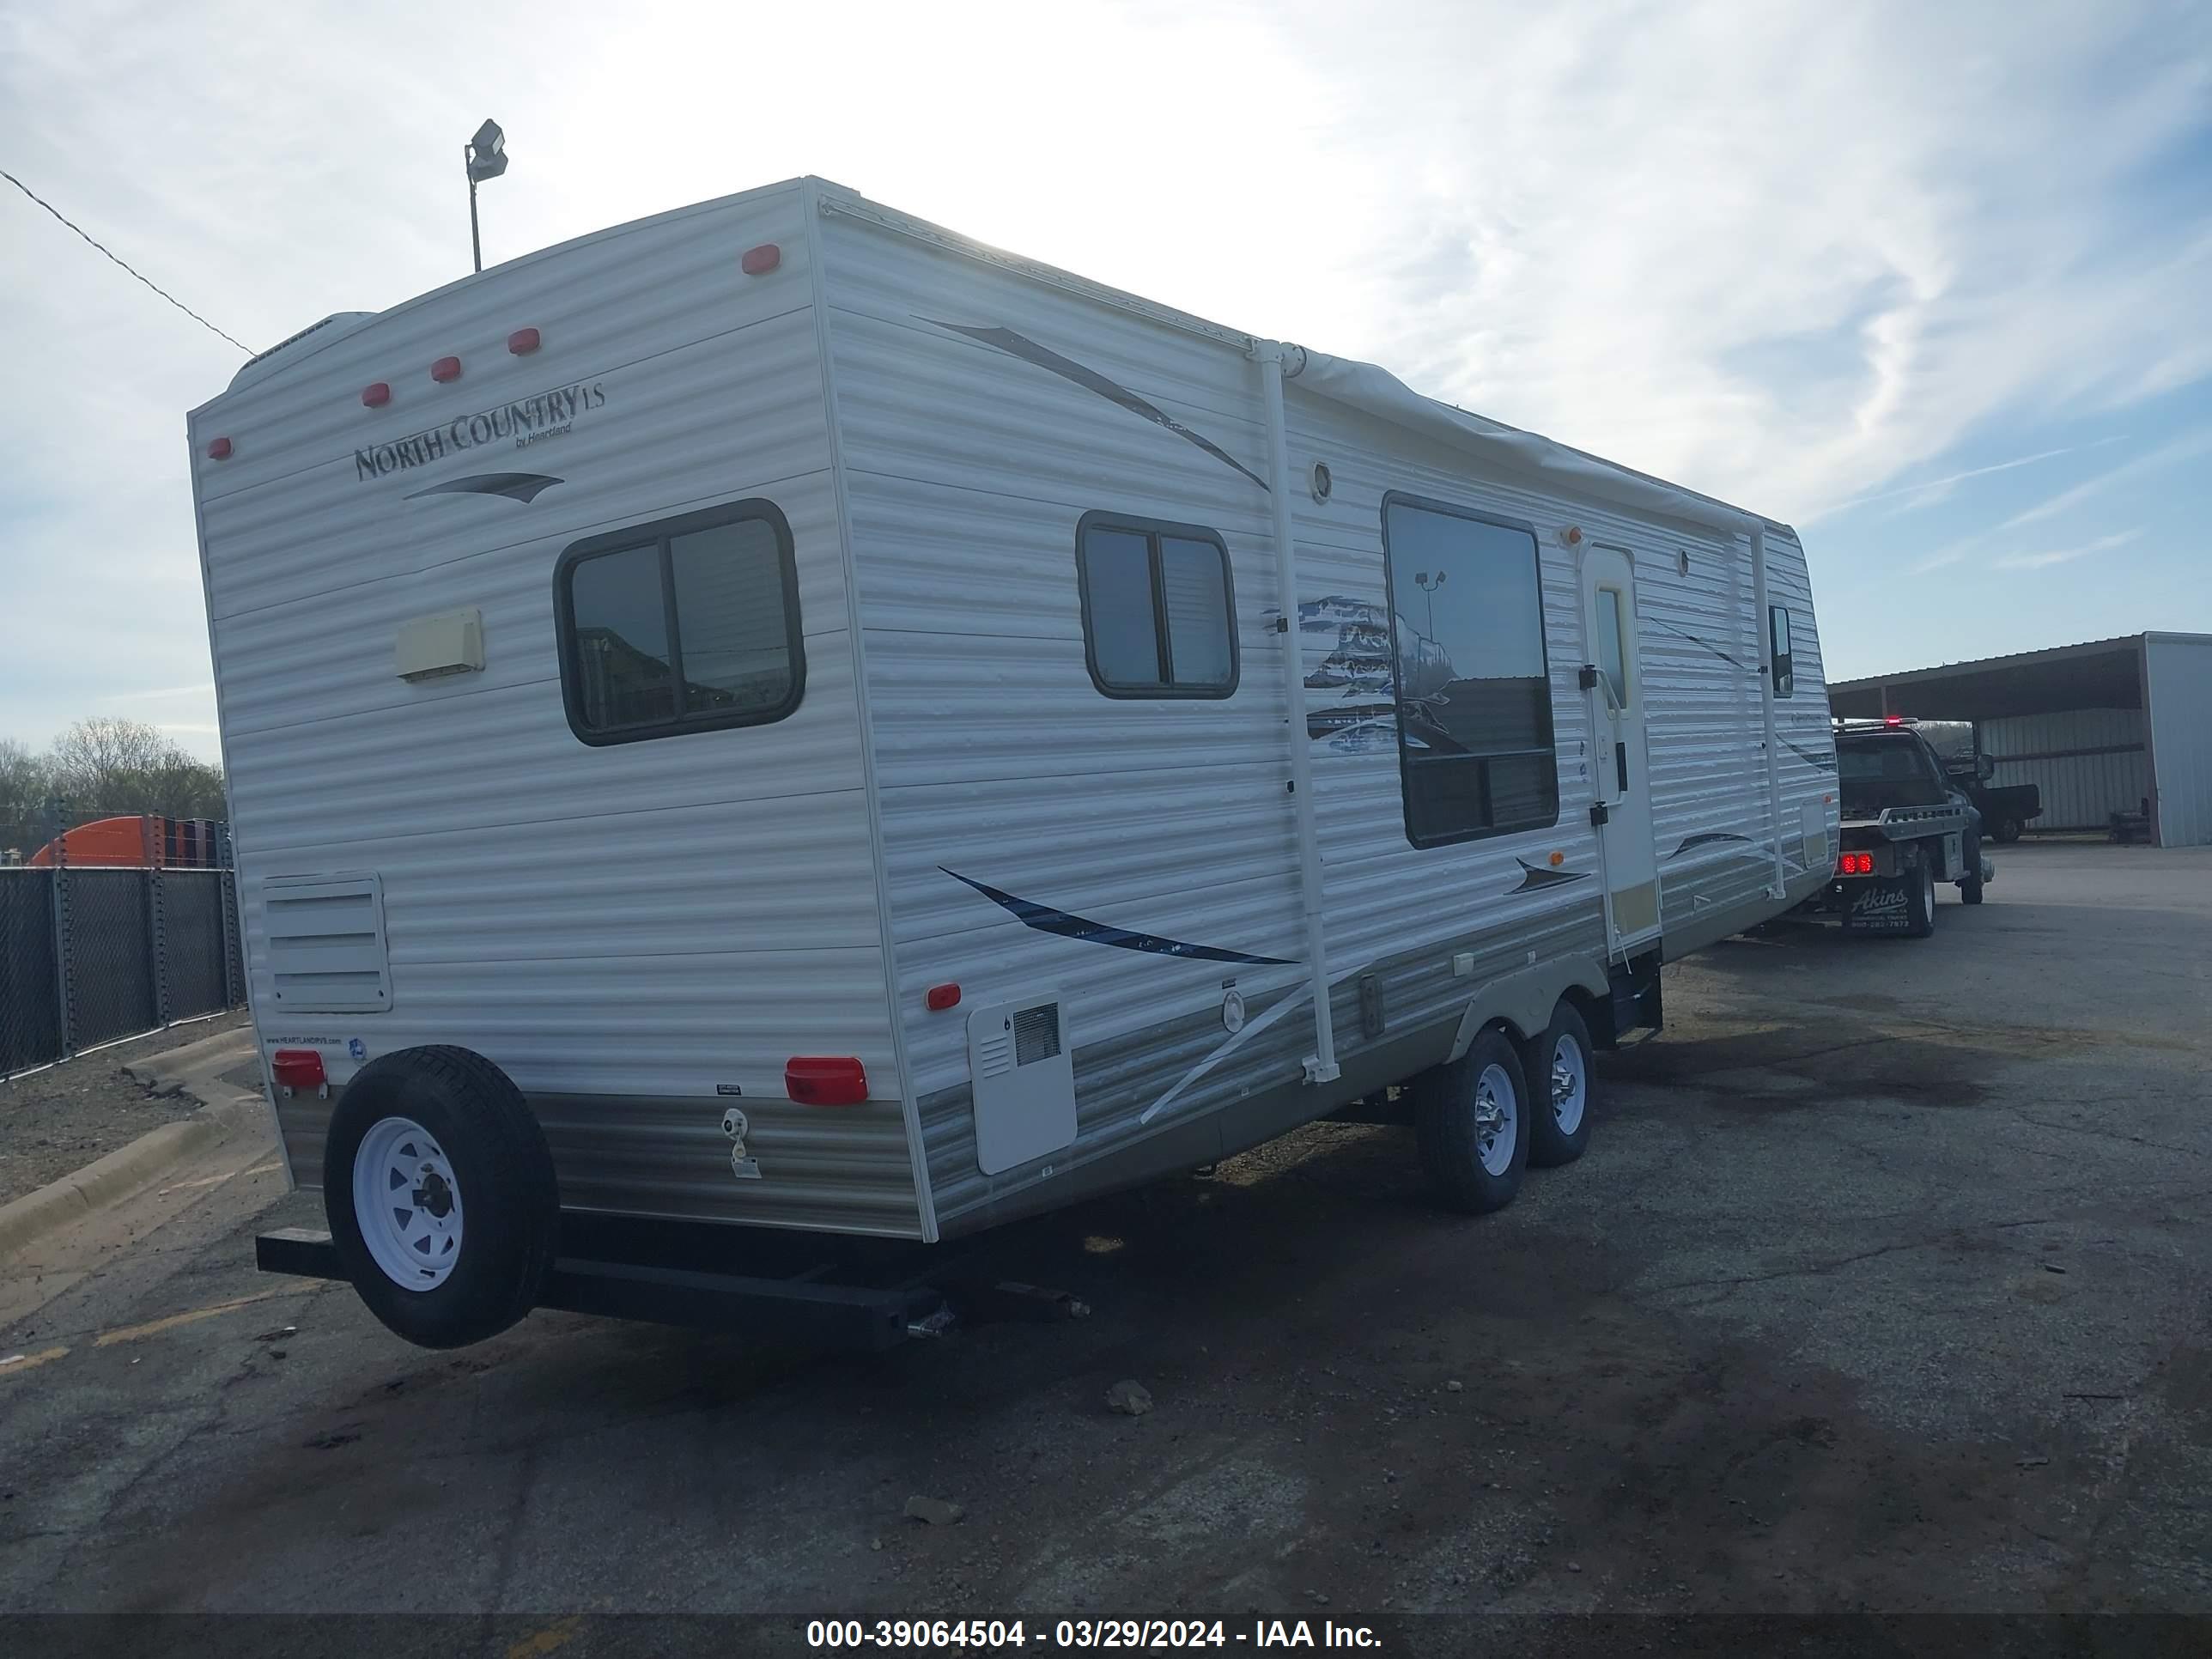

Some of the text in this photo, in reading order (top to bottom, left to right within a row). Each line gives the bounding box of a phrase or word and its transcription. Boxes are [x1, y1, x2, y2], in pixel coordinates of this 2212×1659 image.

[355, 429, 445, 482] NORTH
[450, 385, 580, 451] COUNTRY
[516, 421, 572, 447] by Heartland
[1850, 887, 1909, 914] Akins
